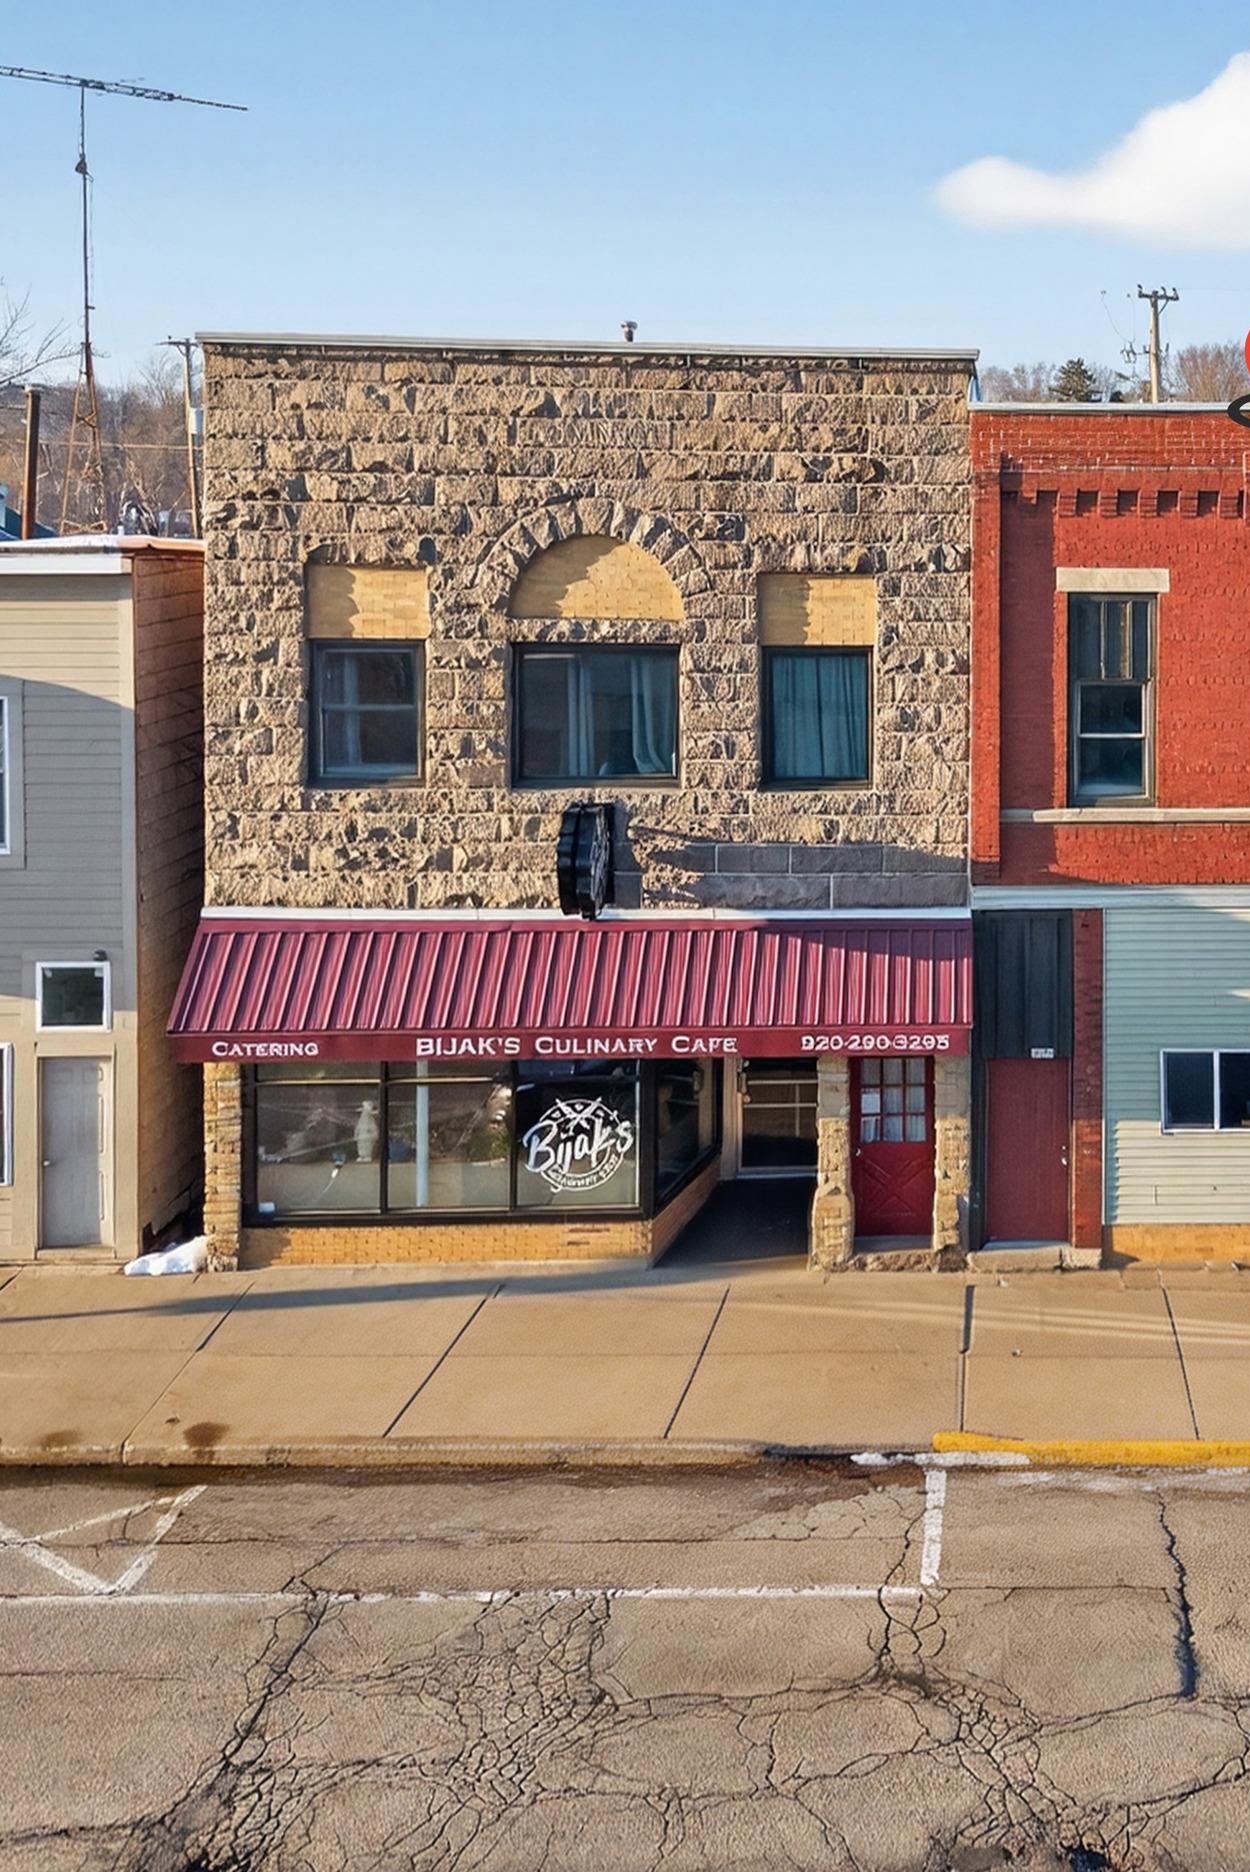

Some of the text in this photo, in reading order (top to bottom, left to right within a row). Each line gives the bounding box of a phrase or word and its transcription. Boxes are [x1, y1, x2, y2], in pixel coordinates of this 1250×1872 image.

[211, 1041, 319, 1056] CATERING
[416, 1036, 738, 1056] BIJAK'S CULINARY CAFE
